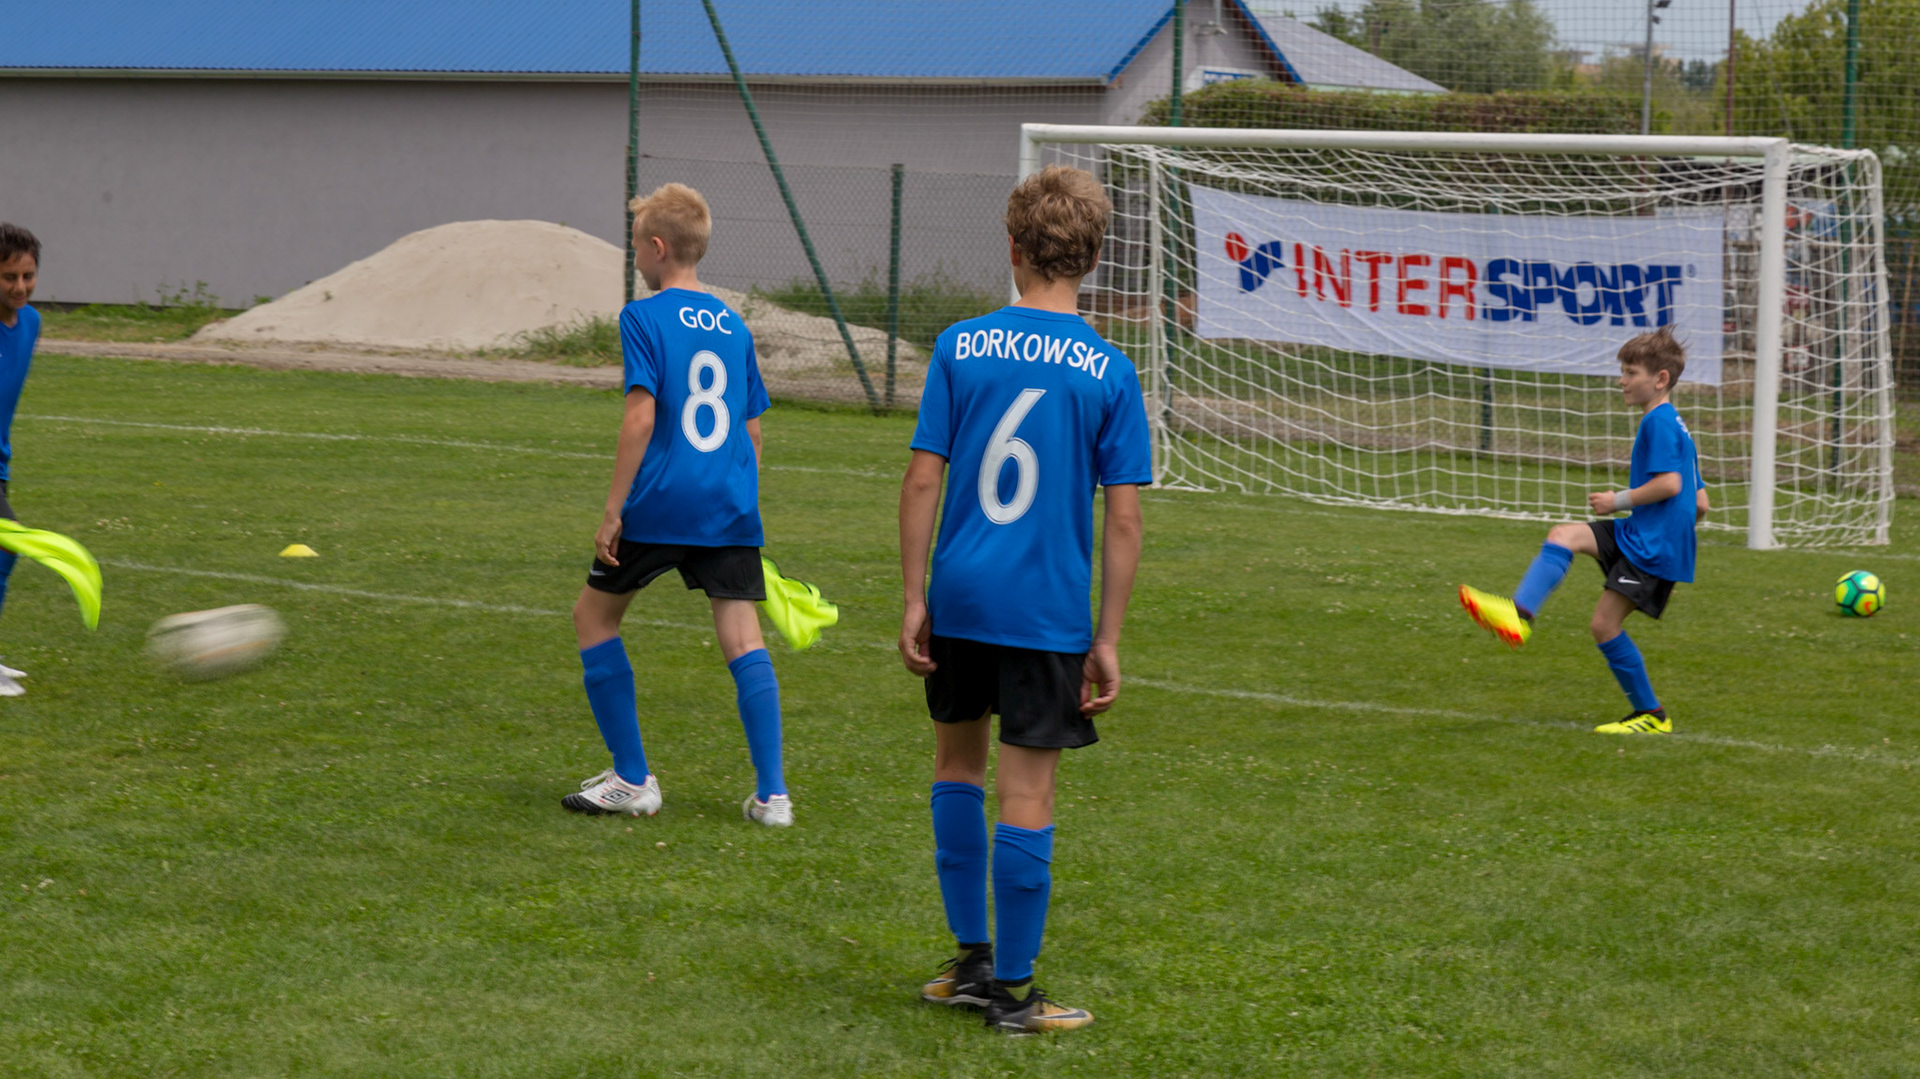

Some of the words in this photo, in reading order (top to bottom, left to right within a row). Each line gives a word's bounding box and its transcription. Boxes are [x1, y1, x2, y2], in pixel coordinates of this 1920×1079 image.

[678, 306, 732, 335] GOĆ
[1293, 241, 1683, 328] INTERSPORT
[955, 328, 1110, 381] BORKOWSKI
[681, 350, 731, 453] 8
[978, 388, 1047, 525] 6
